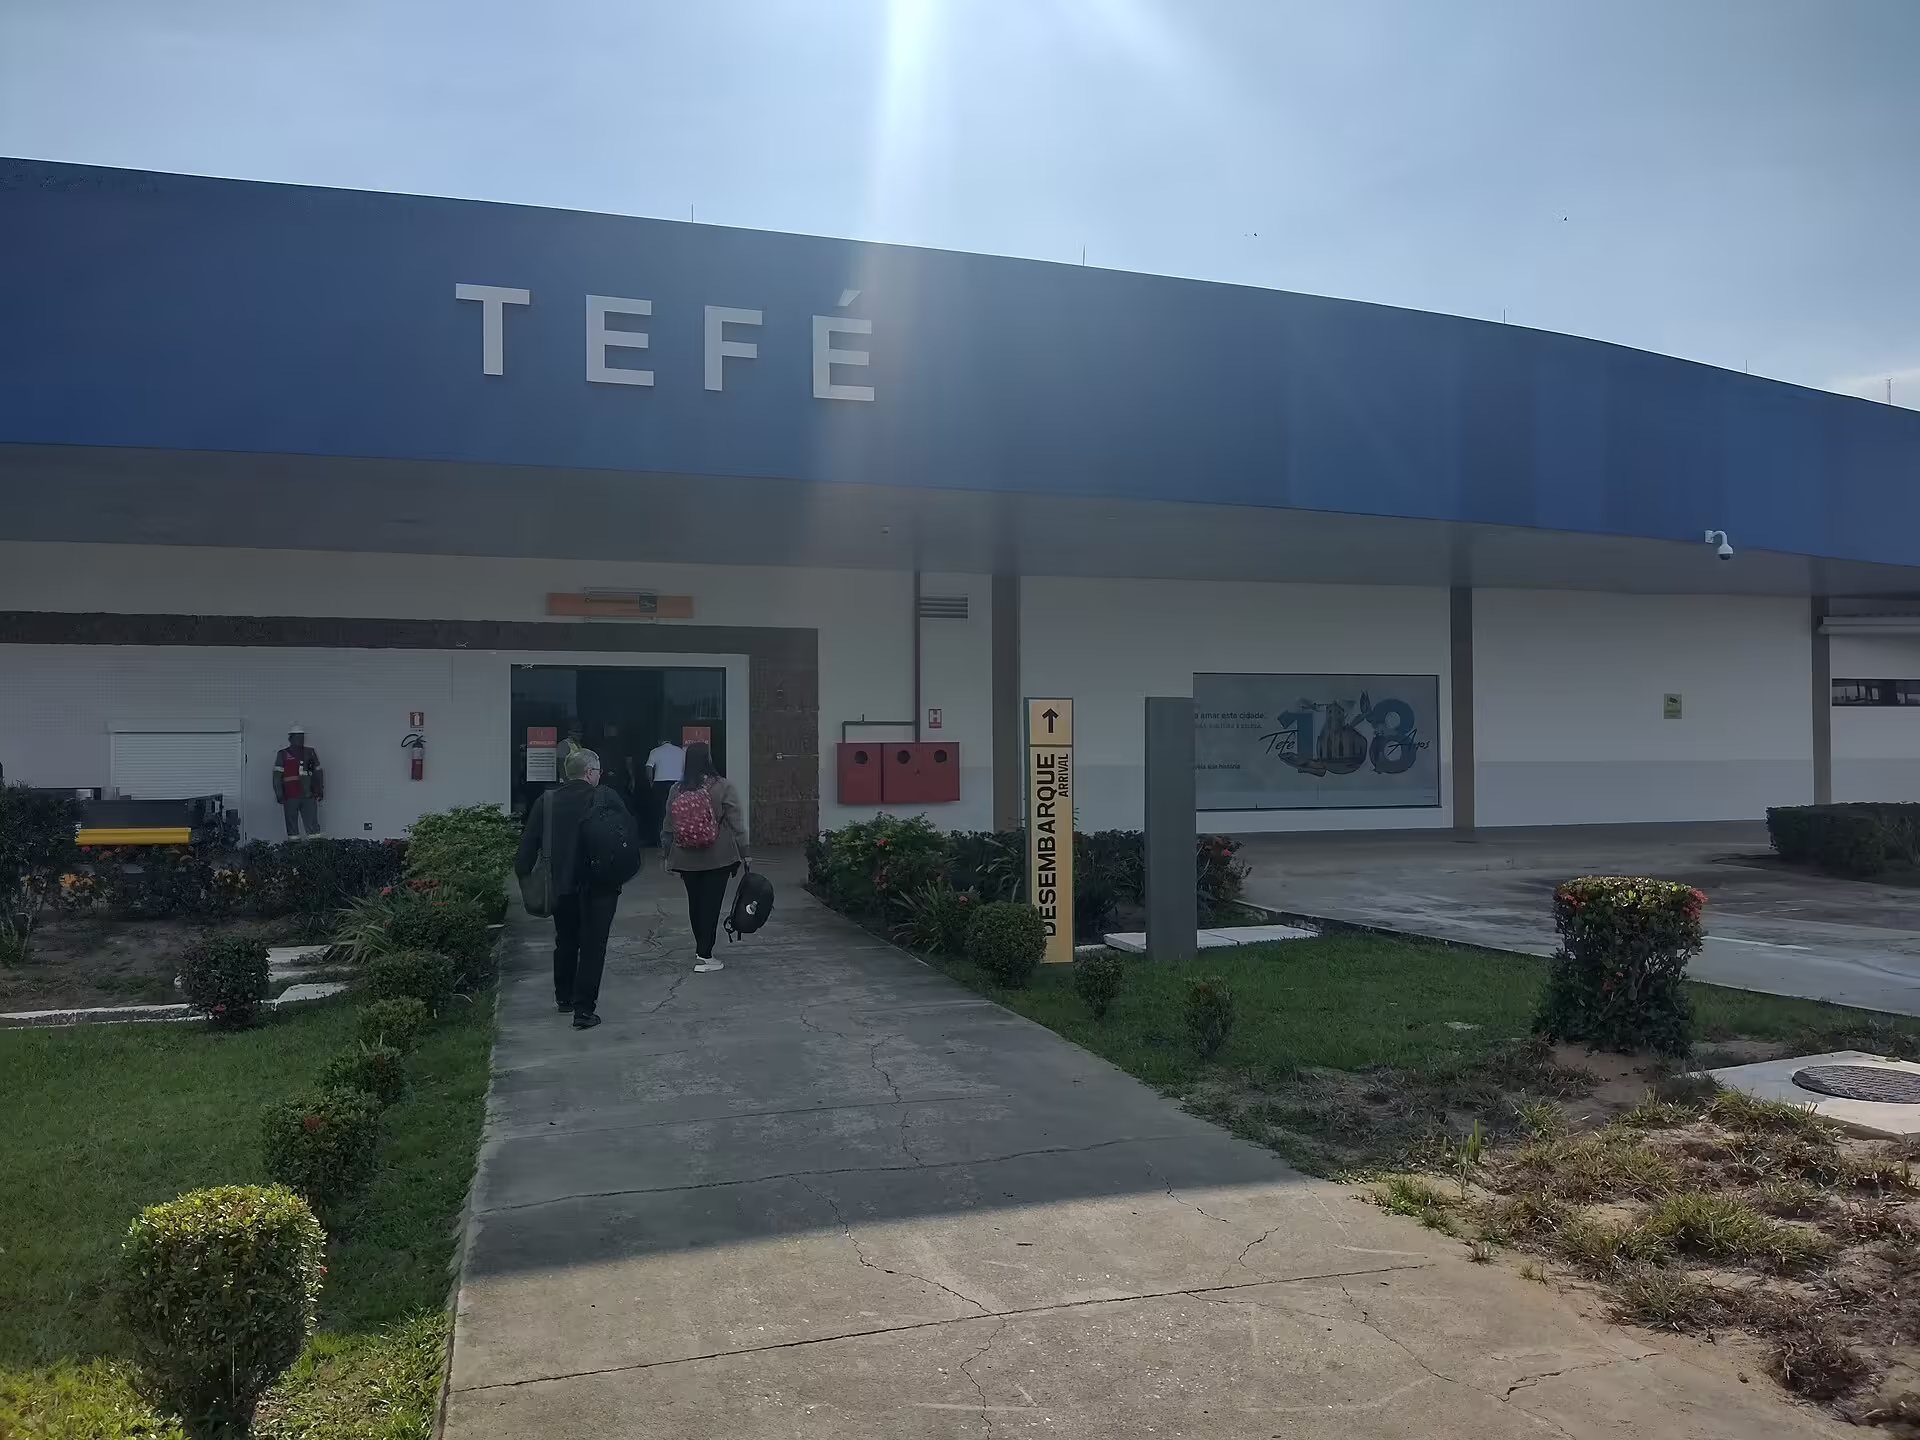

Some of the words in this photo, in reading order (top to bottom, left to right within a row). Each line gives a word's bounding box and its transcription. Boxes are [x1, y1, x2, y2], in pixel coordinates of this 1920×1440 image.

[455, 283, 875, 401] TEFÉ
[1058, 753, 1069, 798] ARRIVAL
[1036, 753, 1058, 937] DESEMBARQUE
